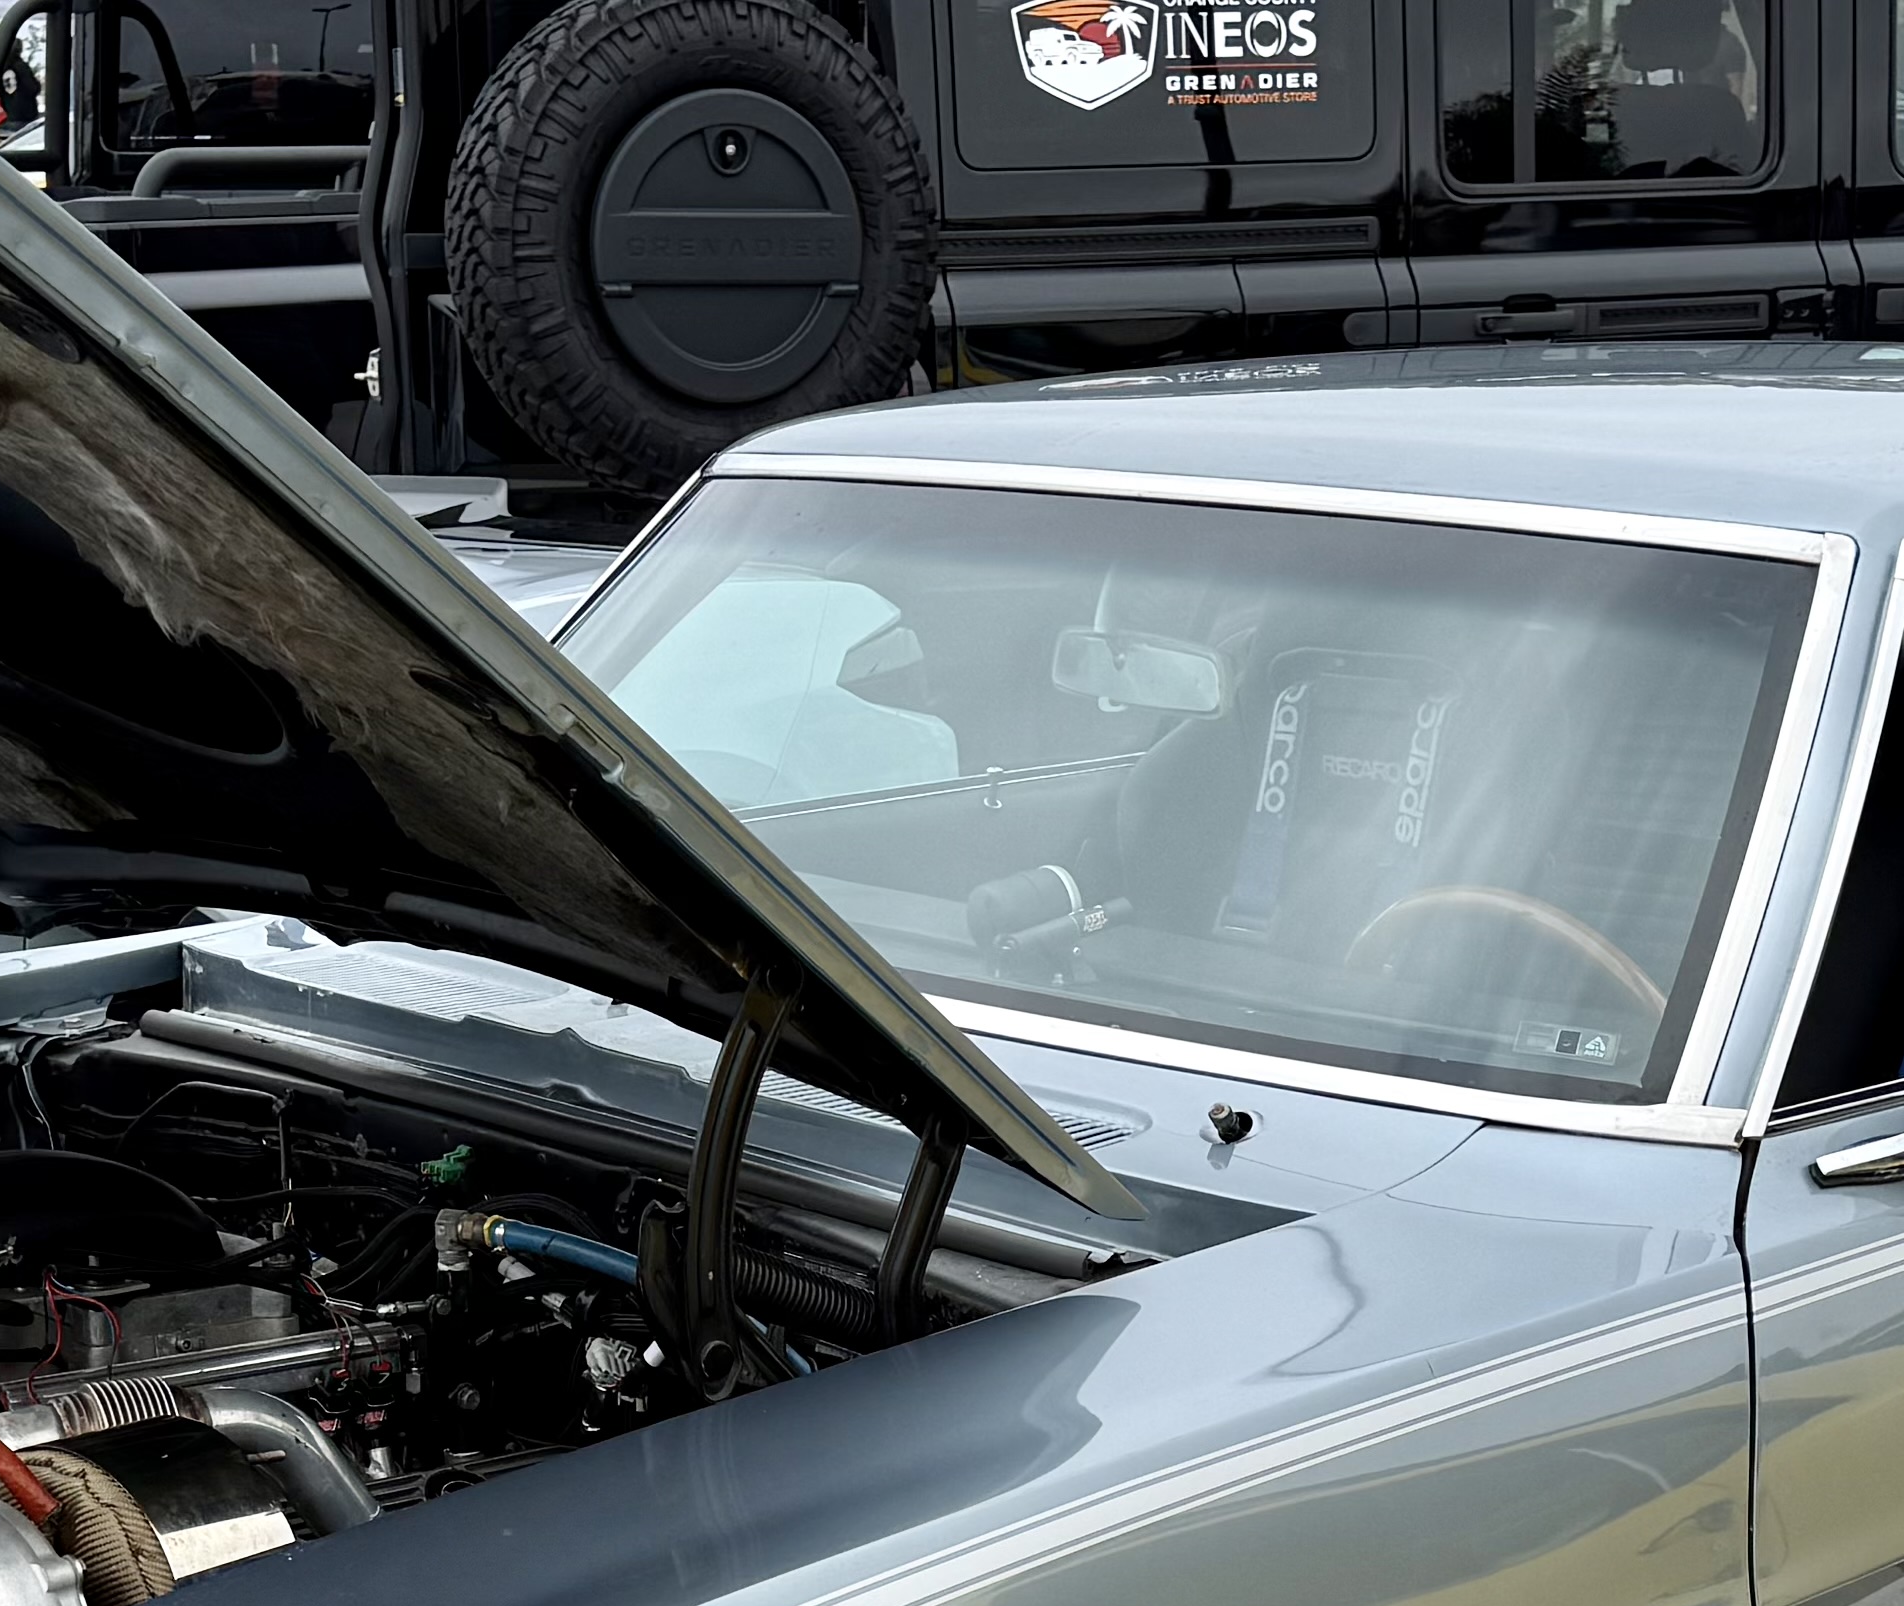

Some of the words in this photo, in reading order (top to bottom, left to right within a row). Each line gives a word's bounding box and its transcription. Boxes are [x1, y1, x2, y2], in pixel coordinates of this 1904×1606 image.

[1164, 9, 1317, 59] INEOS
[1165, 72, 1318, 91] GRENADIER
[1283, 91, 1318, 103] STORE
[1257, 684, 1307, 813] parco
[1322, 755, 1402, 784] RECARO
[1395, 698, 1443, 846] sparc
